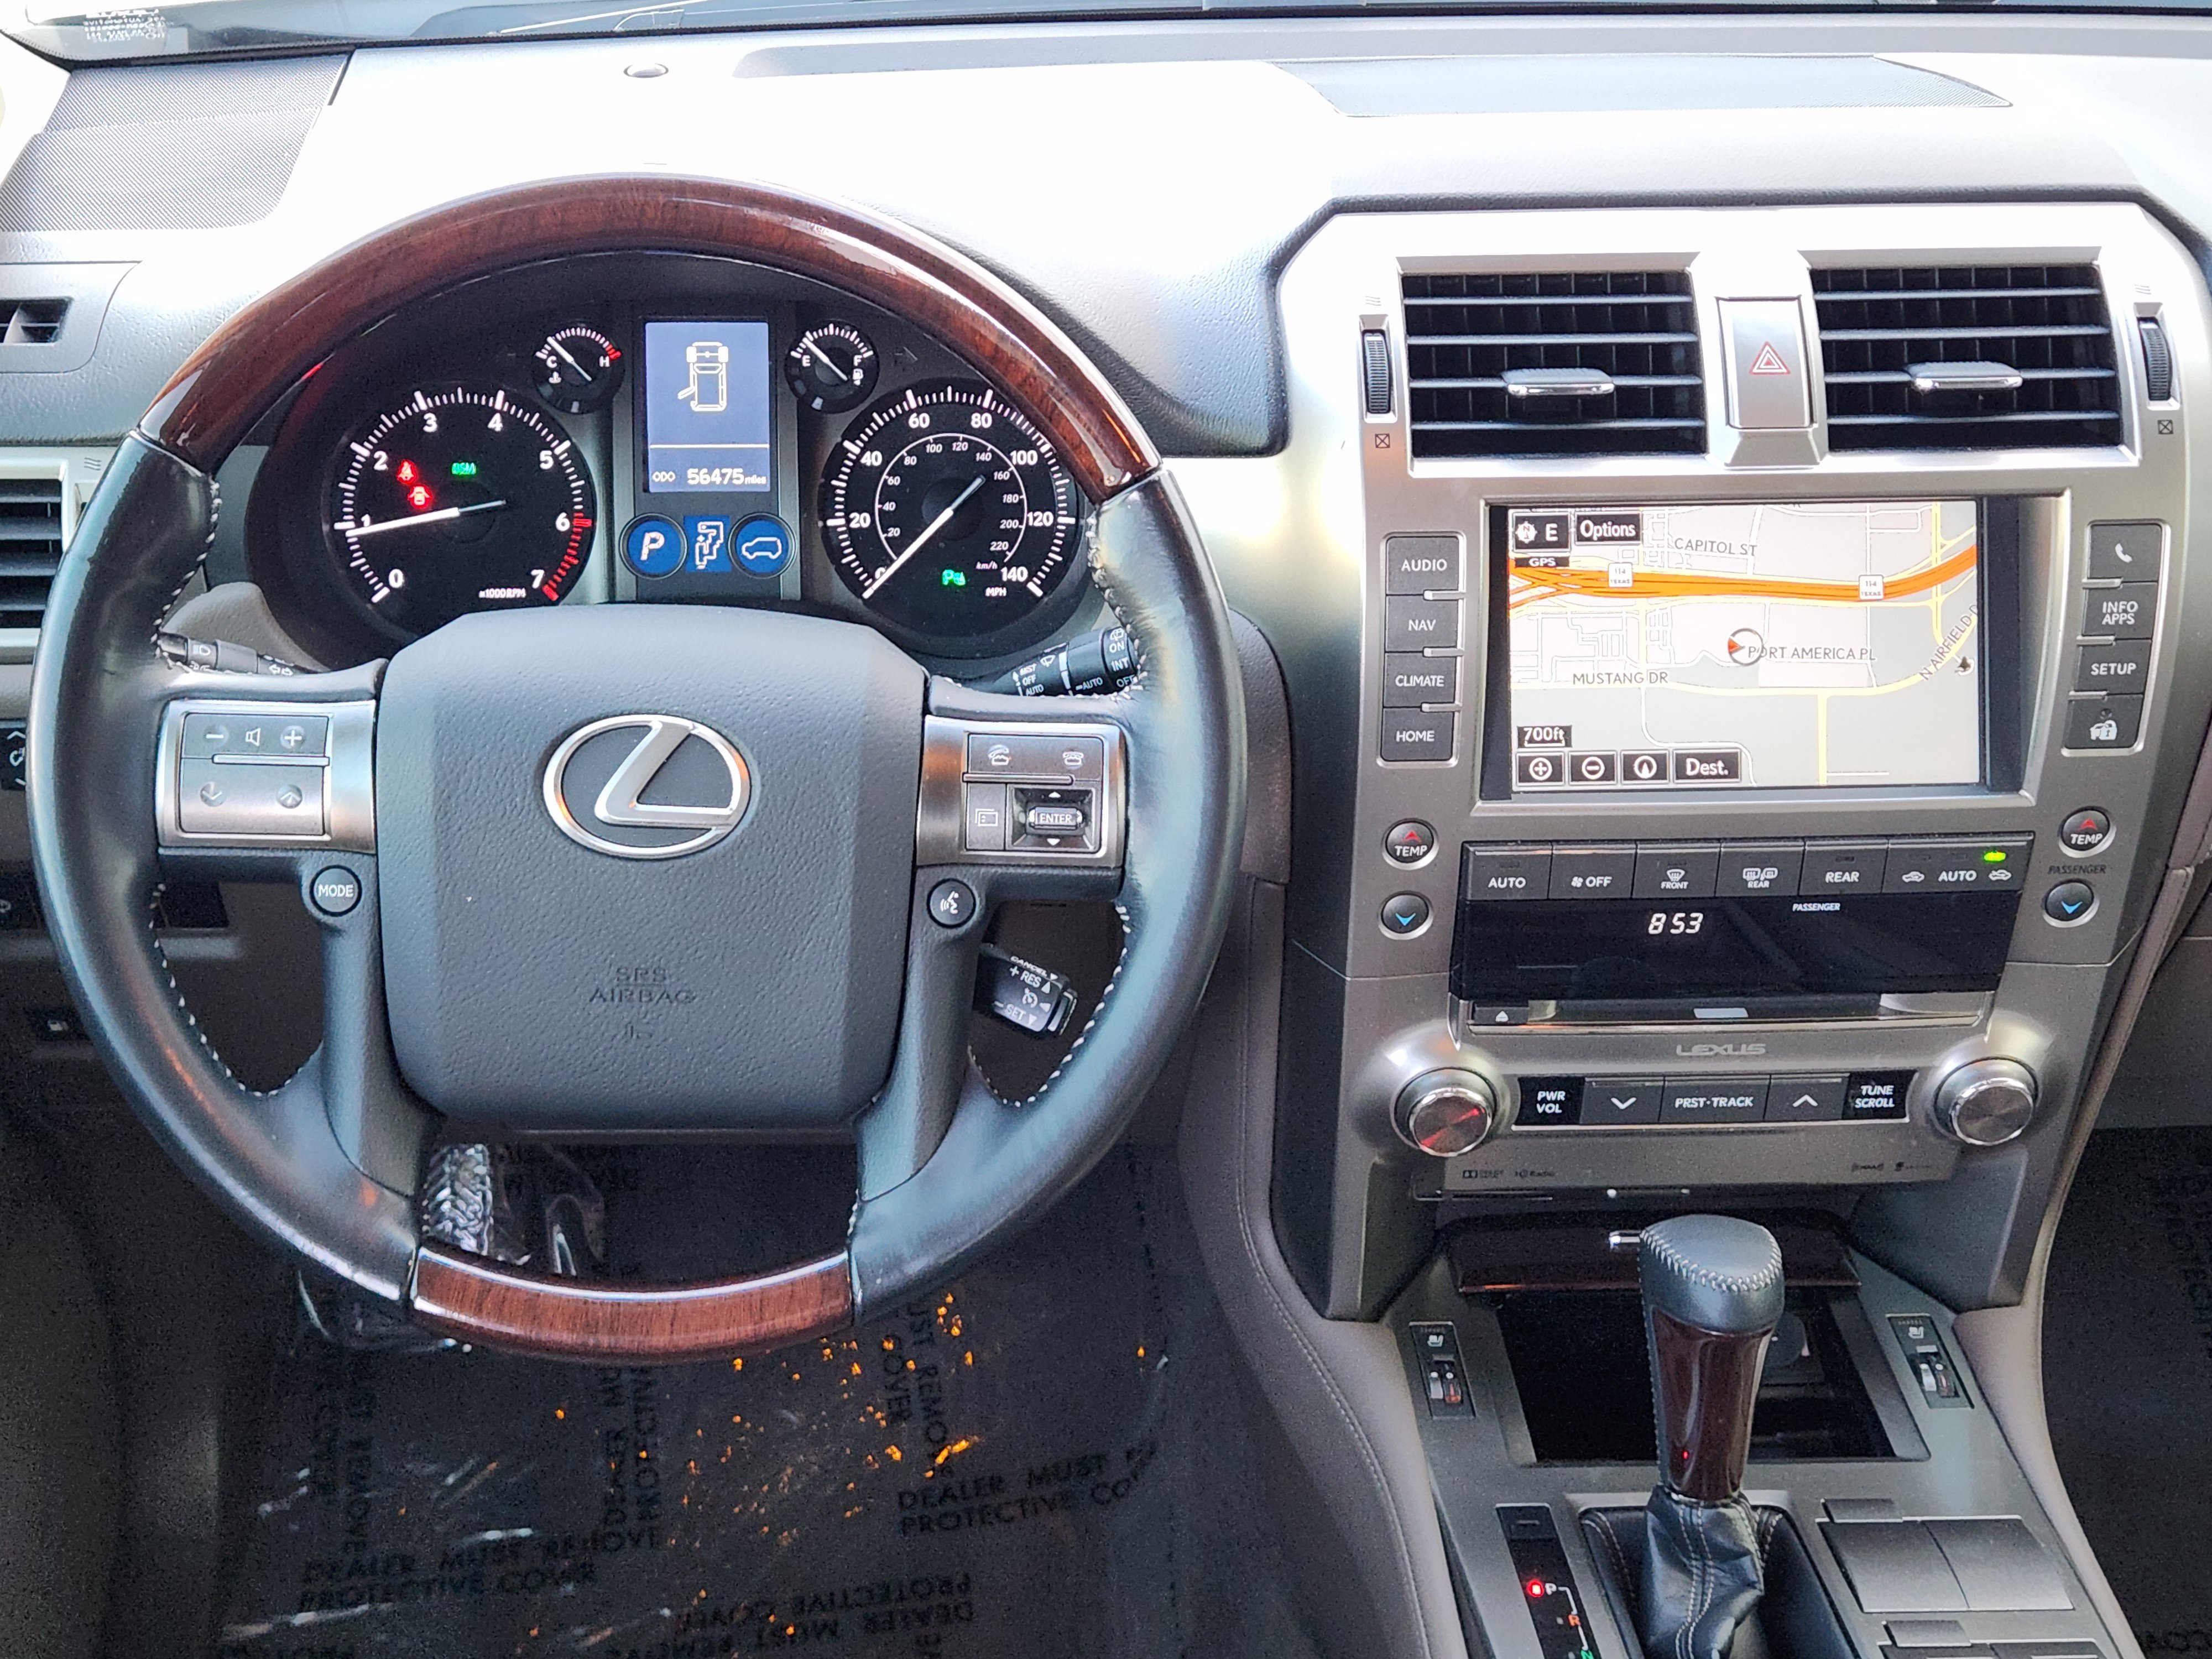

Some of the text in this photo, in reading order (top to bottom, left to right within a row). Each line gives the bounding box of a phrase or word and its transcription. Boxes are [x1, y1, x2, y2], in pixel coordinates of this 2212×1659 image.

[423, 413, 438, 433] 3
[488, 413, 503, 432] 4
[909, 413, 930, 428] 60
[971, 413, 992, 428] 80
[373, 450, 388, 471] 2
[539, 451, 554, 470] 5
[861, 451, 882, 466] 40
[1010, 450, 1038, 466] 100
[556, 512, 570, 531] 6
[849, 512, 871, 528] 20
[1027, 511, 1053, 526] 120
[1580, 520, 1636, 541] Options
[1674, 538, 1758, 556] CAPITOL ST
[1401, 559, 1448, 572] AUDIO
[1528, 558, 1556, 567] GPS
[388, 568, 404, 588] 0
[531, 570, 545, 589] 7
[1001, 566, 1027, 582] 140
[985, 587, 1006, 597] MPH
[2103, 601, 2138, 613] INFO
[1408, 619, 1436, 632] NAV
[2101, 613, 2135, 625] APPS
[1109, 641, 1126, 653] ON
[1748, 646, 1876, 661] PORT AMERICA PL
[1919, 667, 1933, 681] N
[1931, 615, 1972, 671] AIRFIELD
[1111, 658, 1129, 672] INT
[2090, 662, 2137, 675] SETUP
[1395, 675, 1444, 687] CLIMATE
[1573, 672, 1668, 685] MUSTANG DR
[1396, 730, 1435, 742] HOME
[1686, 757, 1729, 776] Dest.
[1040, 812, 1072, 825] ENTER
[2070, 833, 2103, 845] TEMP
[1394, 844, 1428, 857] TEMP
[1938, 870, 1977, 882] AUTO
[2048, 864, 2106, 875] PASSENGER
[1488, 877, 1526, 889] AUTO
[1585, 877, 1612, 887] OFF
[1825, 871, 1859, 883] REAR
[318, 884, 354, 898] MODE
[1661, 881, 1689, 890] FRONT
[1792, 902, 1841, 912] PASSENGER
[1020, 971, 1041, 988] RES
[589, 987, 698, 1005] AIRBAG
[1006, 1004, 1026, 1020] SET
[1676, 1043, 1767, 1057] LEXUS
[1537, 1091, 1566, 1100] PWR
[1860, 1084, 1894, 1095] TUNE
[1537, 1103, 1562, 1114] VOL
[1855, 1097, 1895, 1109] SCROLL
[1545, 1583, 1557, 1595] P
